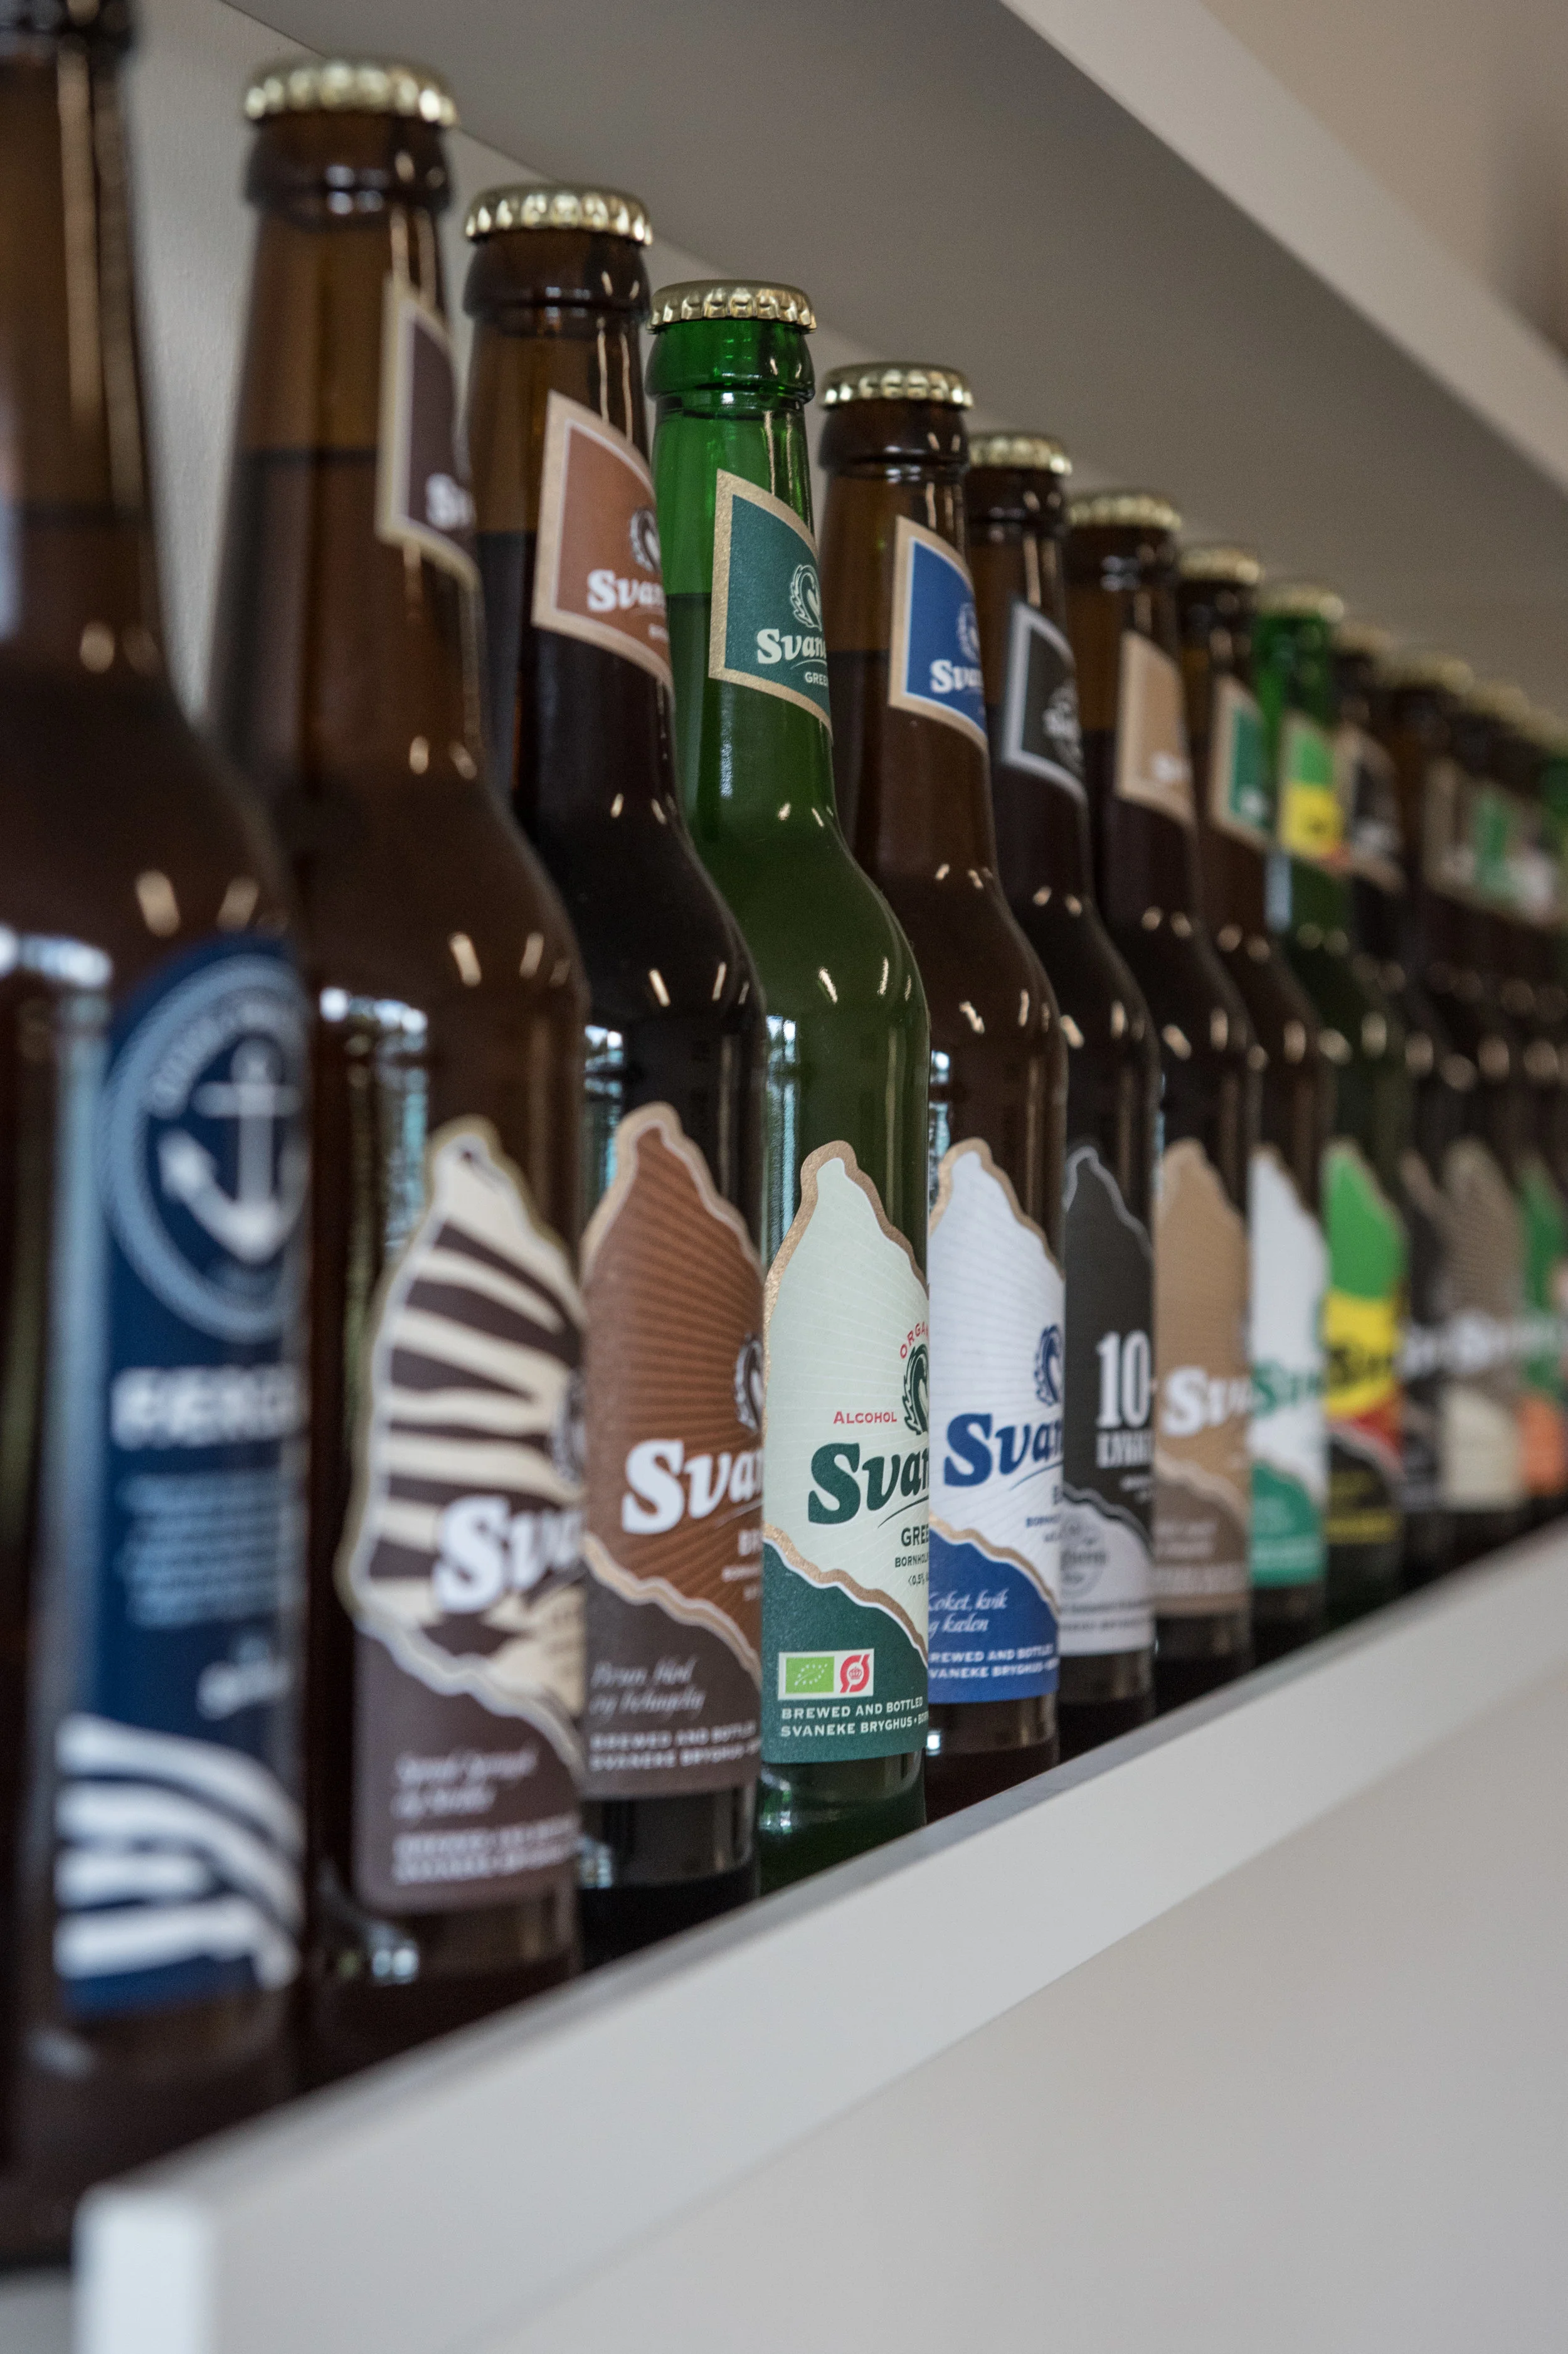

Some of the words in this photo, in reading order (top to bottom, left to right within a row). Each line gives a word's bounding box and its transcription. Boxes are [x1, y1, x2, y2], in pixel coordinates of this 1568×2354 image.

[833, 1411, 898, 1424] ALCOHOL
[930, 1651, 985, 1663] REWED
[929, 1667, 989, 1679] VANEKE
[781, 1705, 851, 1720] BREWED
[856, 1703, 882, 1717] AND
[886, 1696, 923, 1714] BOTTLED
[780, 1723, 856, 1737] SVANEKE
[861, 1716, 913, 1734] BRYGHUS
